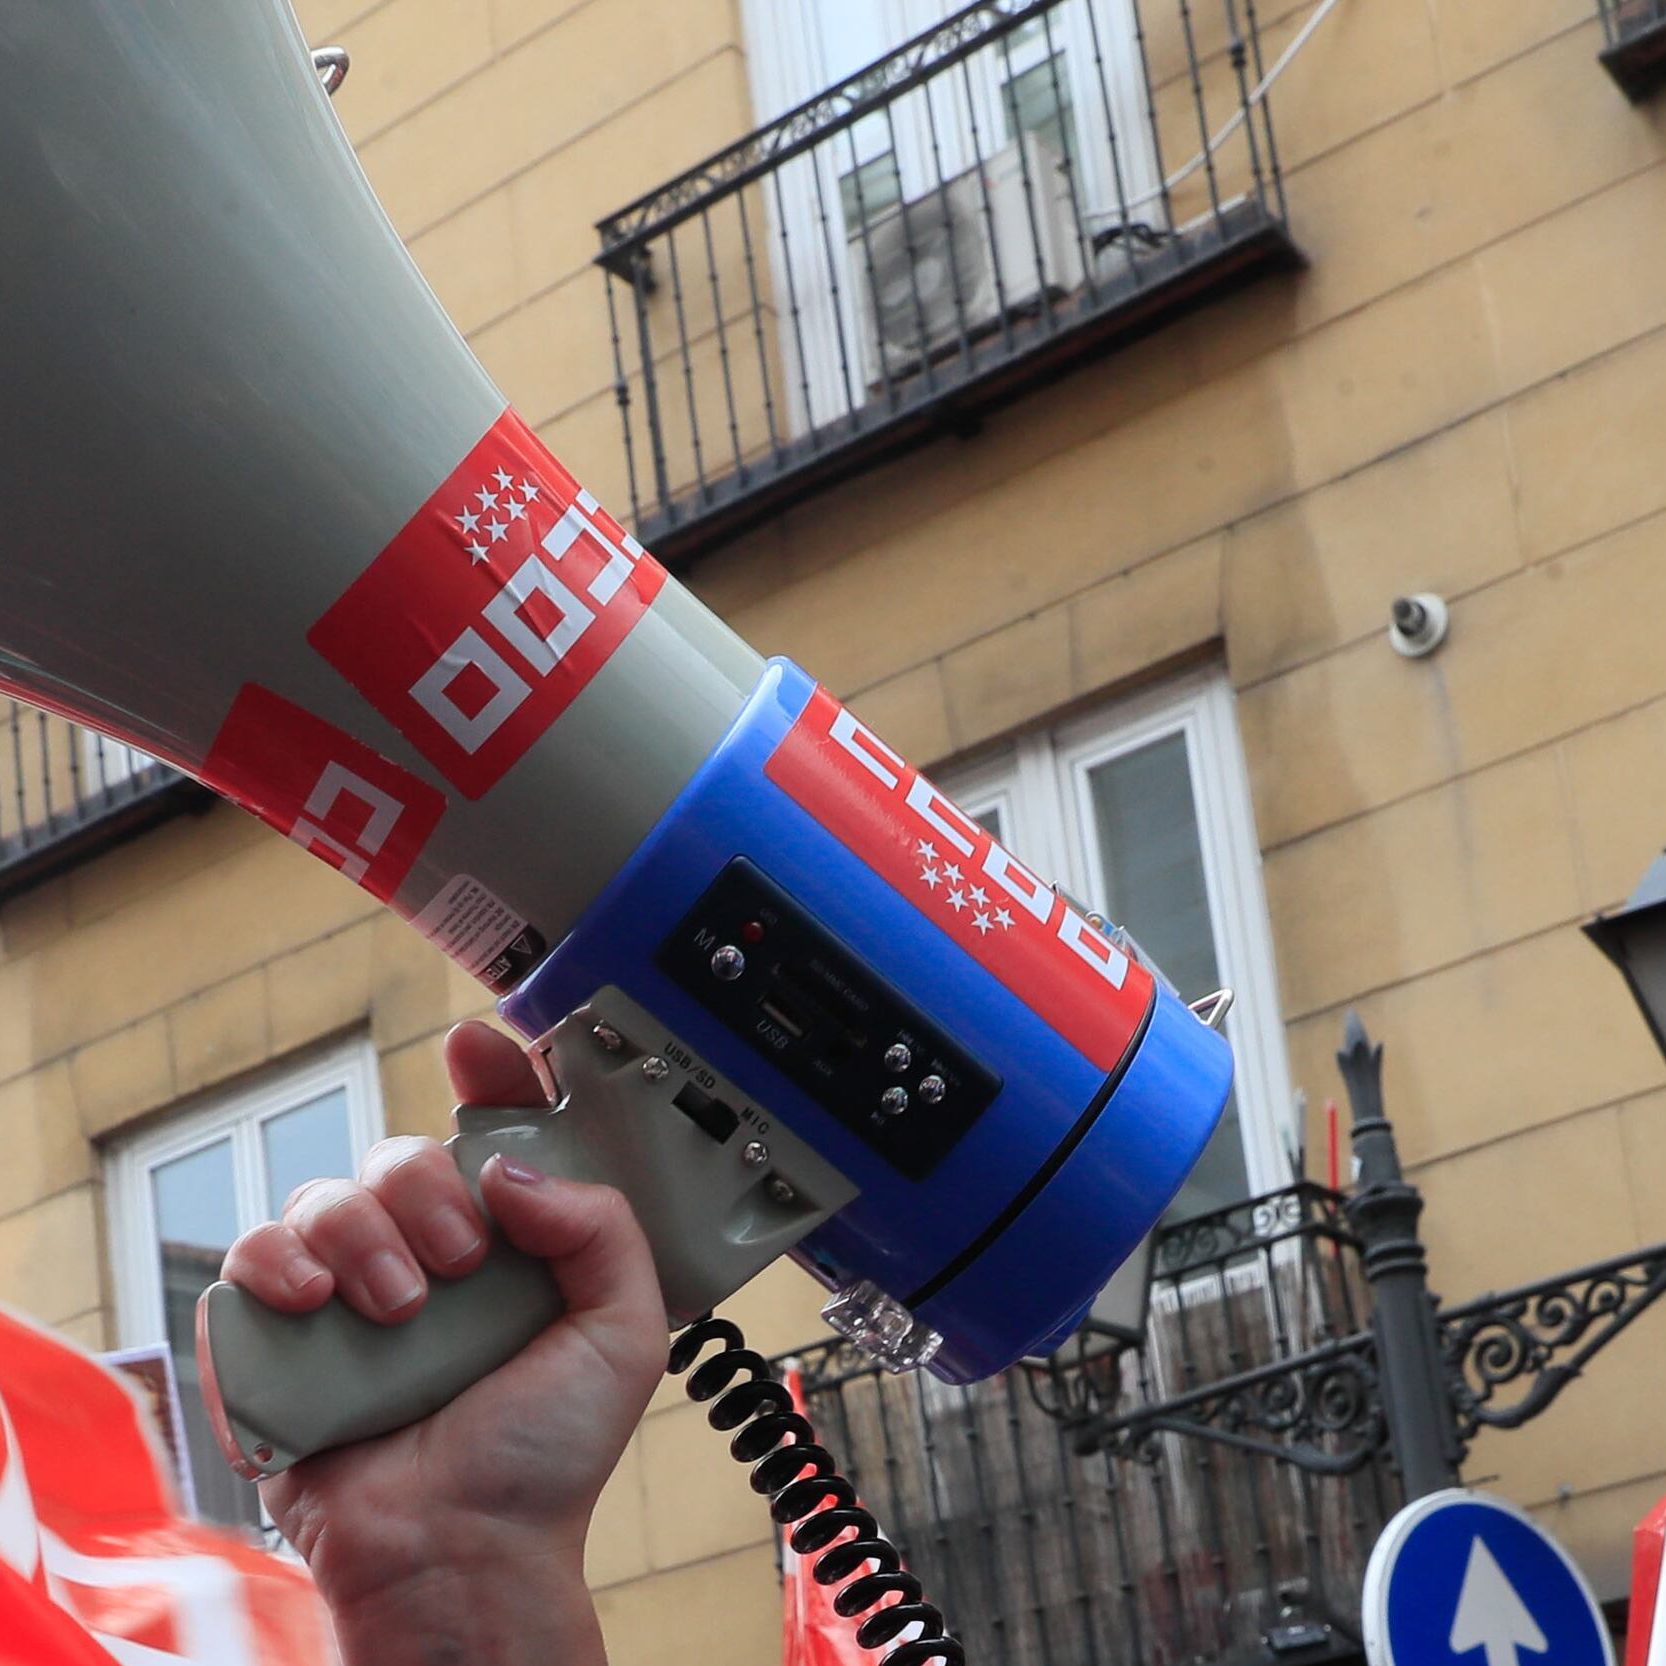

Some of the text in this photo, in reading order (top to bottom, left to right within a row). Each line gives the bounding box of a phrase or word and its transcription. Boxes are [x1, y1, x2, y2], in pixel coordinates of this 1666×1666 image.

[829, 707, 1129, 991] CCOO
[693, 926, 716, 951] M
[756, 1019, 790, 1049] USB
[664, 1041, 717, 1090] USB/SD
[738, 1106, 771, 1135] MIC
